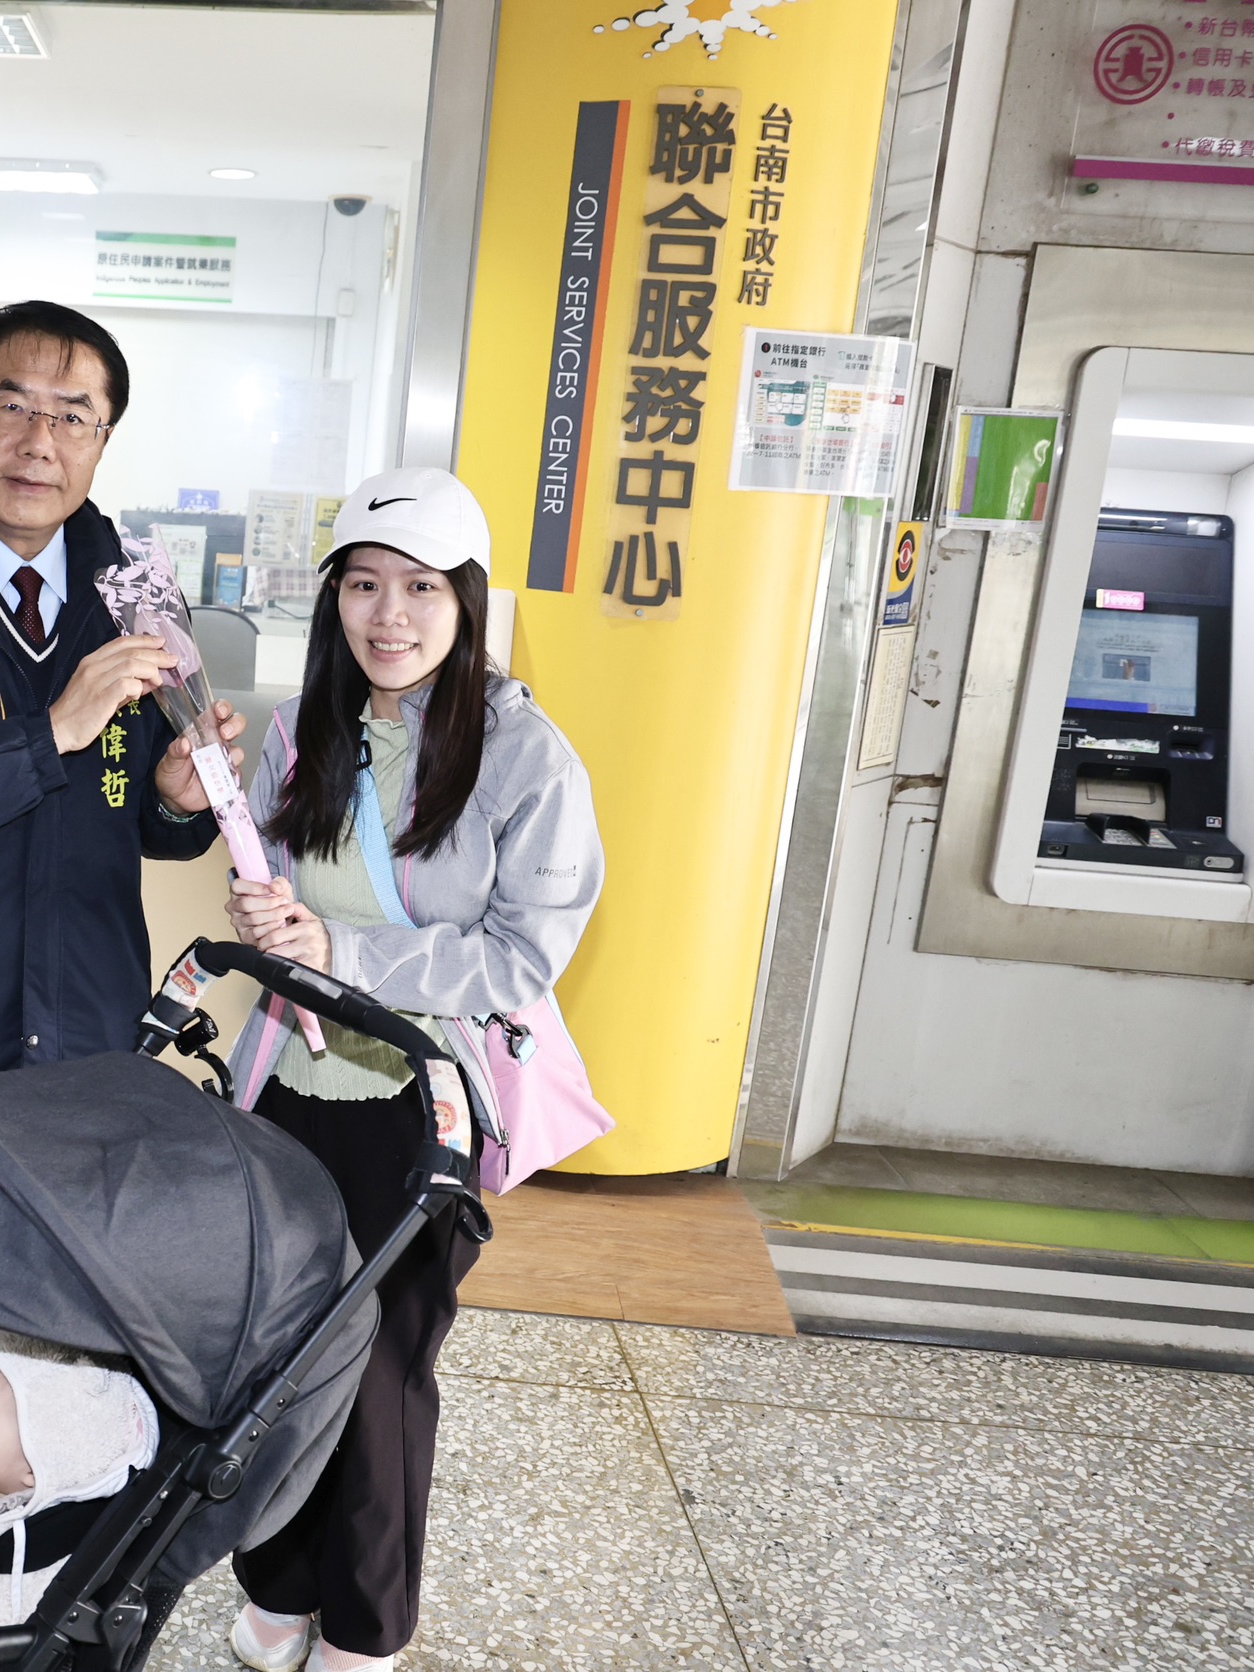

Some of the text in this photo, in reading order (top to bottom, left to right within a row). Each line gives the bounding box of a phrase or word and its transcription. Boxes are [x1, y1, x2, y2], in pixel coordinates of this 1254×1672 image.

[1192, 47, 1253, 68] 信用卡
[737, 103, 793, 307] 台南市政府
[542, 182, 600, 515] JOINT SERVICES CENTER
[603, 100, 736, 607] 聯合服務中心
[773, 344, 827, 357] 前往指定銀行
[100, 710, 130, 808] 偉哲
